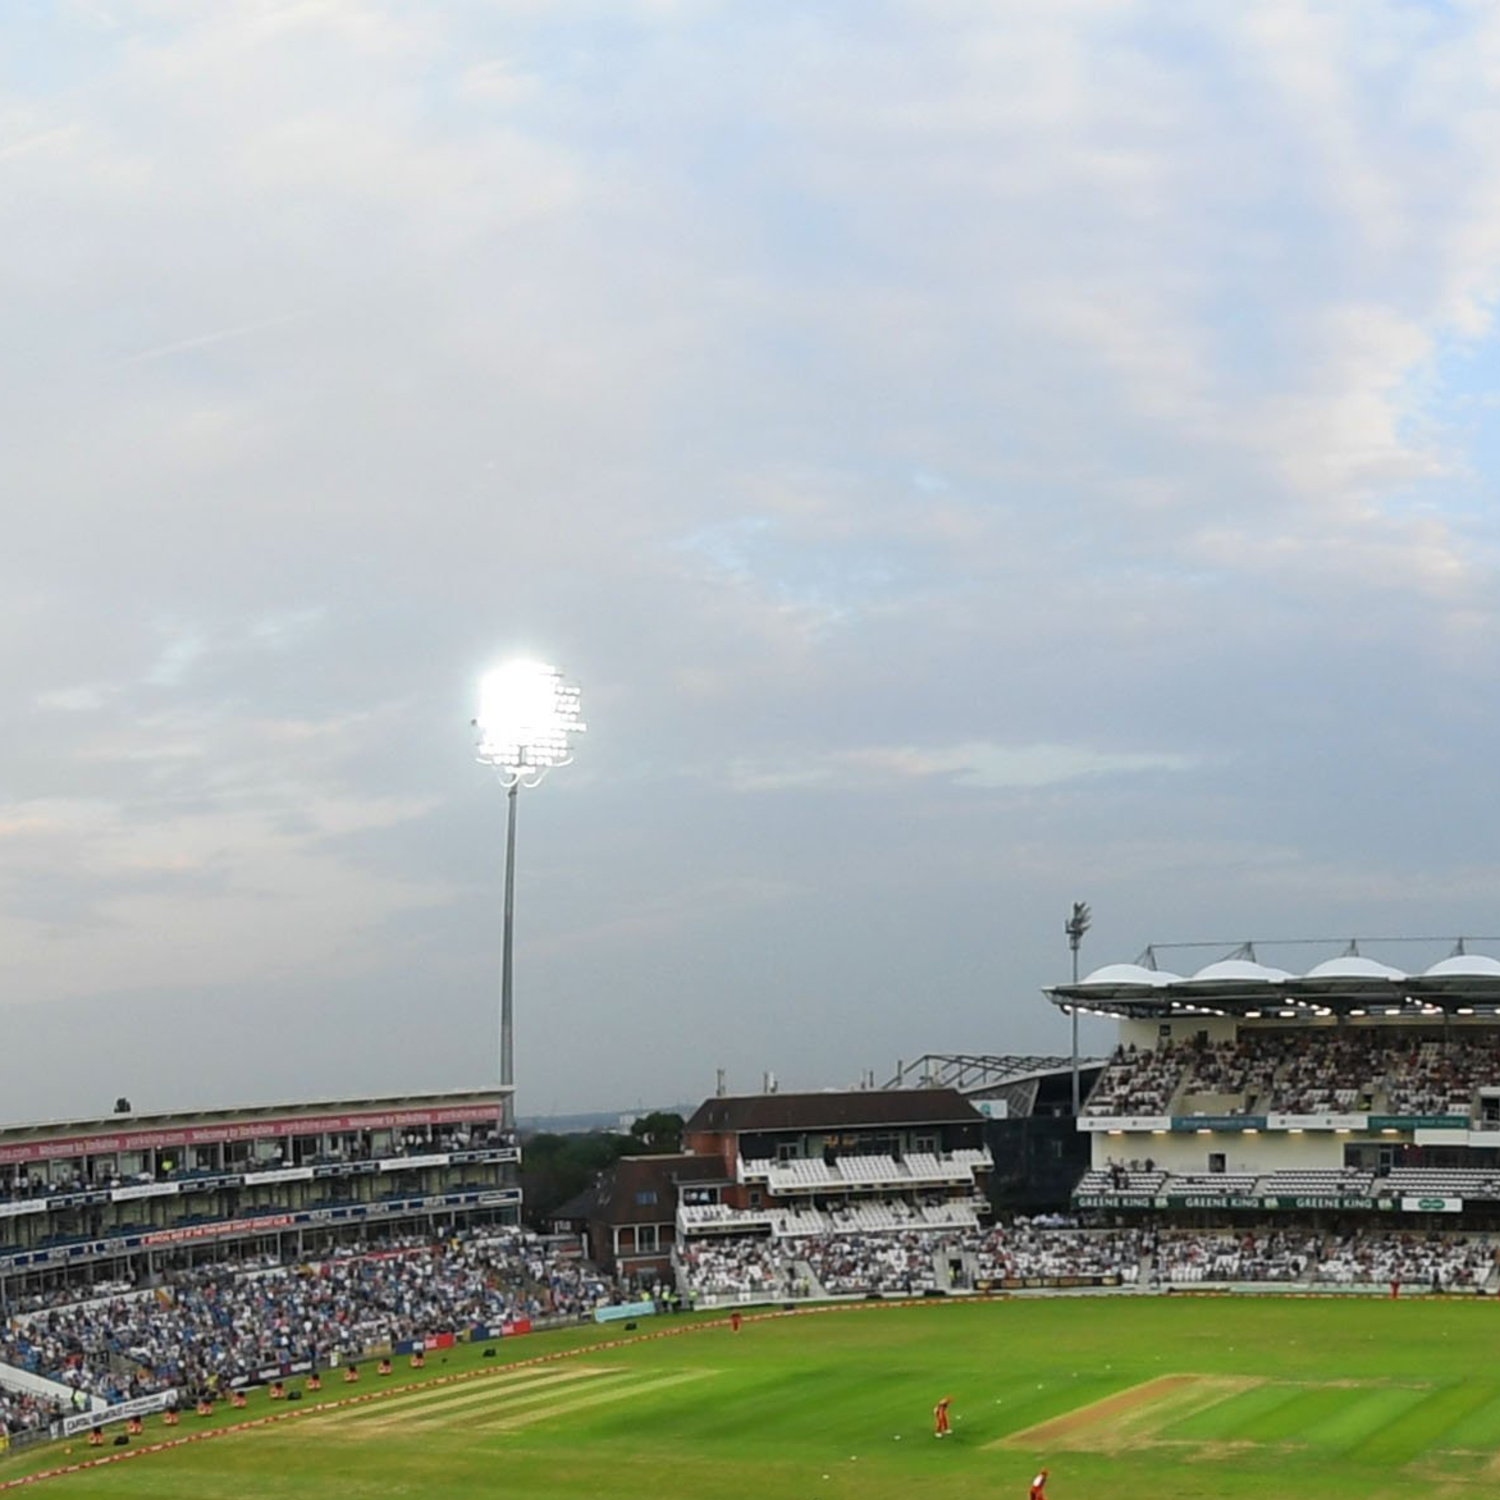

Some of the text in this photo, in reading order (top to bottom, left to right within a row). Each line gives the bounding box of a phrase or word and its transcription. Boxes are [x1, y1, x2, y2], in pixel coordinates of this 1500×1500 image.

[1078, 1197, 1119, 1208] GREENE
[1122, 1197, 1150, 1208] KING
[1185, 1197, 1228, 1208] GREENE
[1231, 1198, 1259, 1209] KING
[1296, 1198, 1338, 1209] GREENE
[1343, 1198, 1373, 1209] KING
